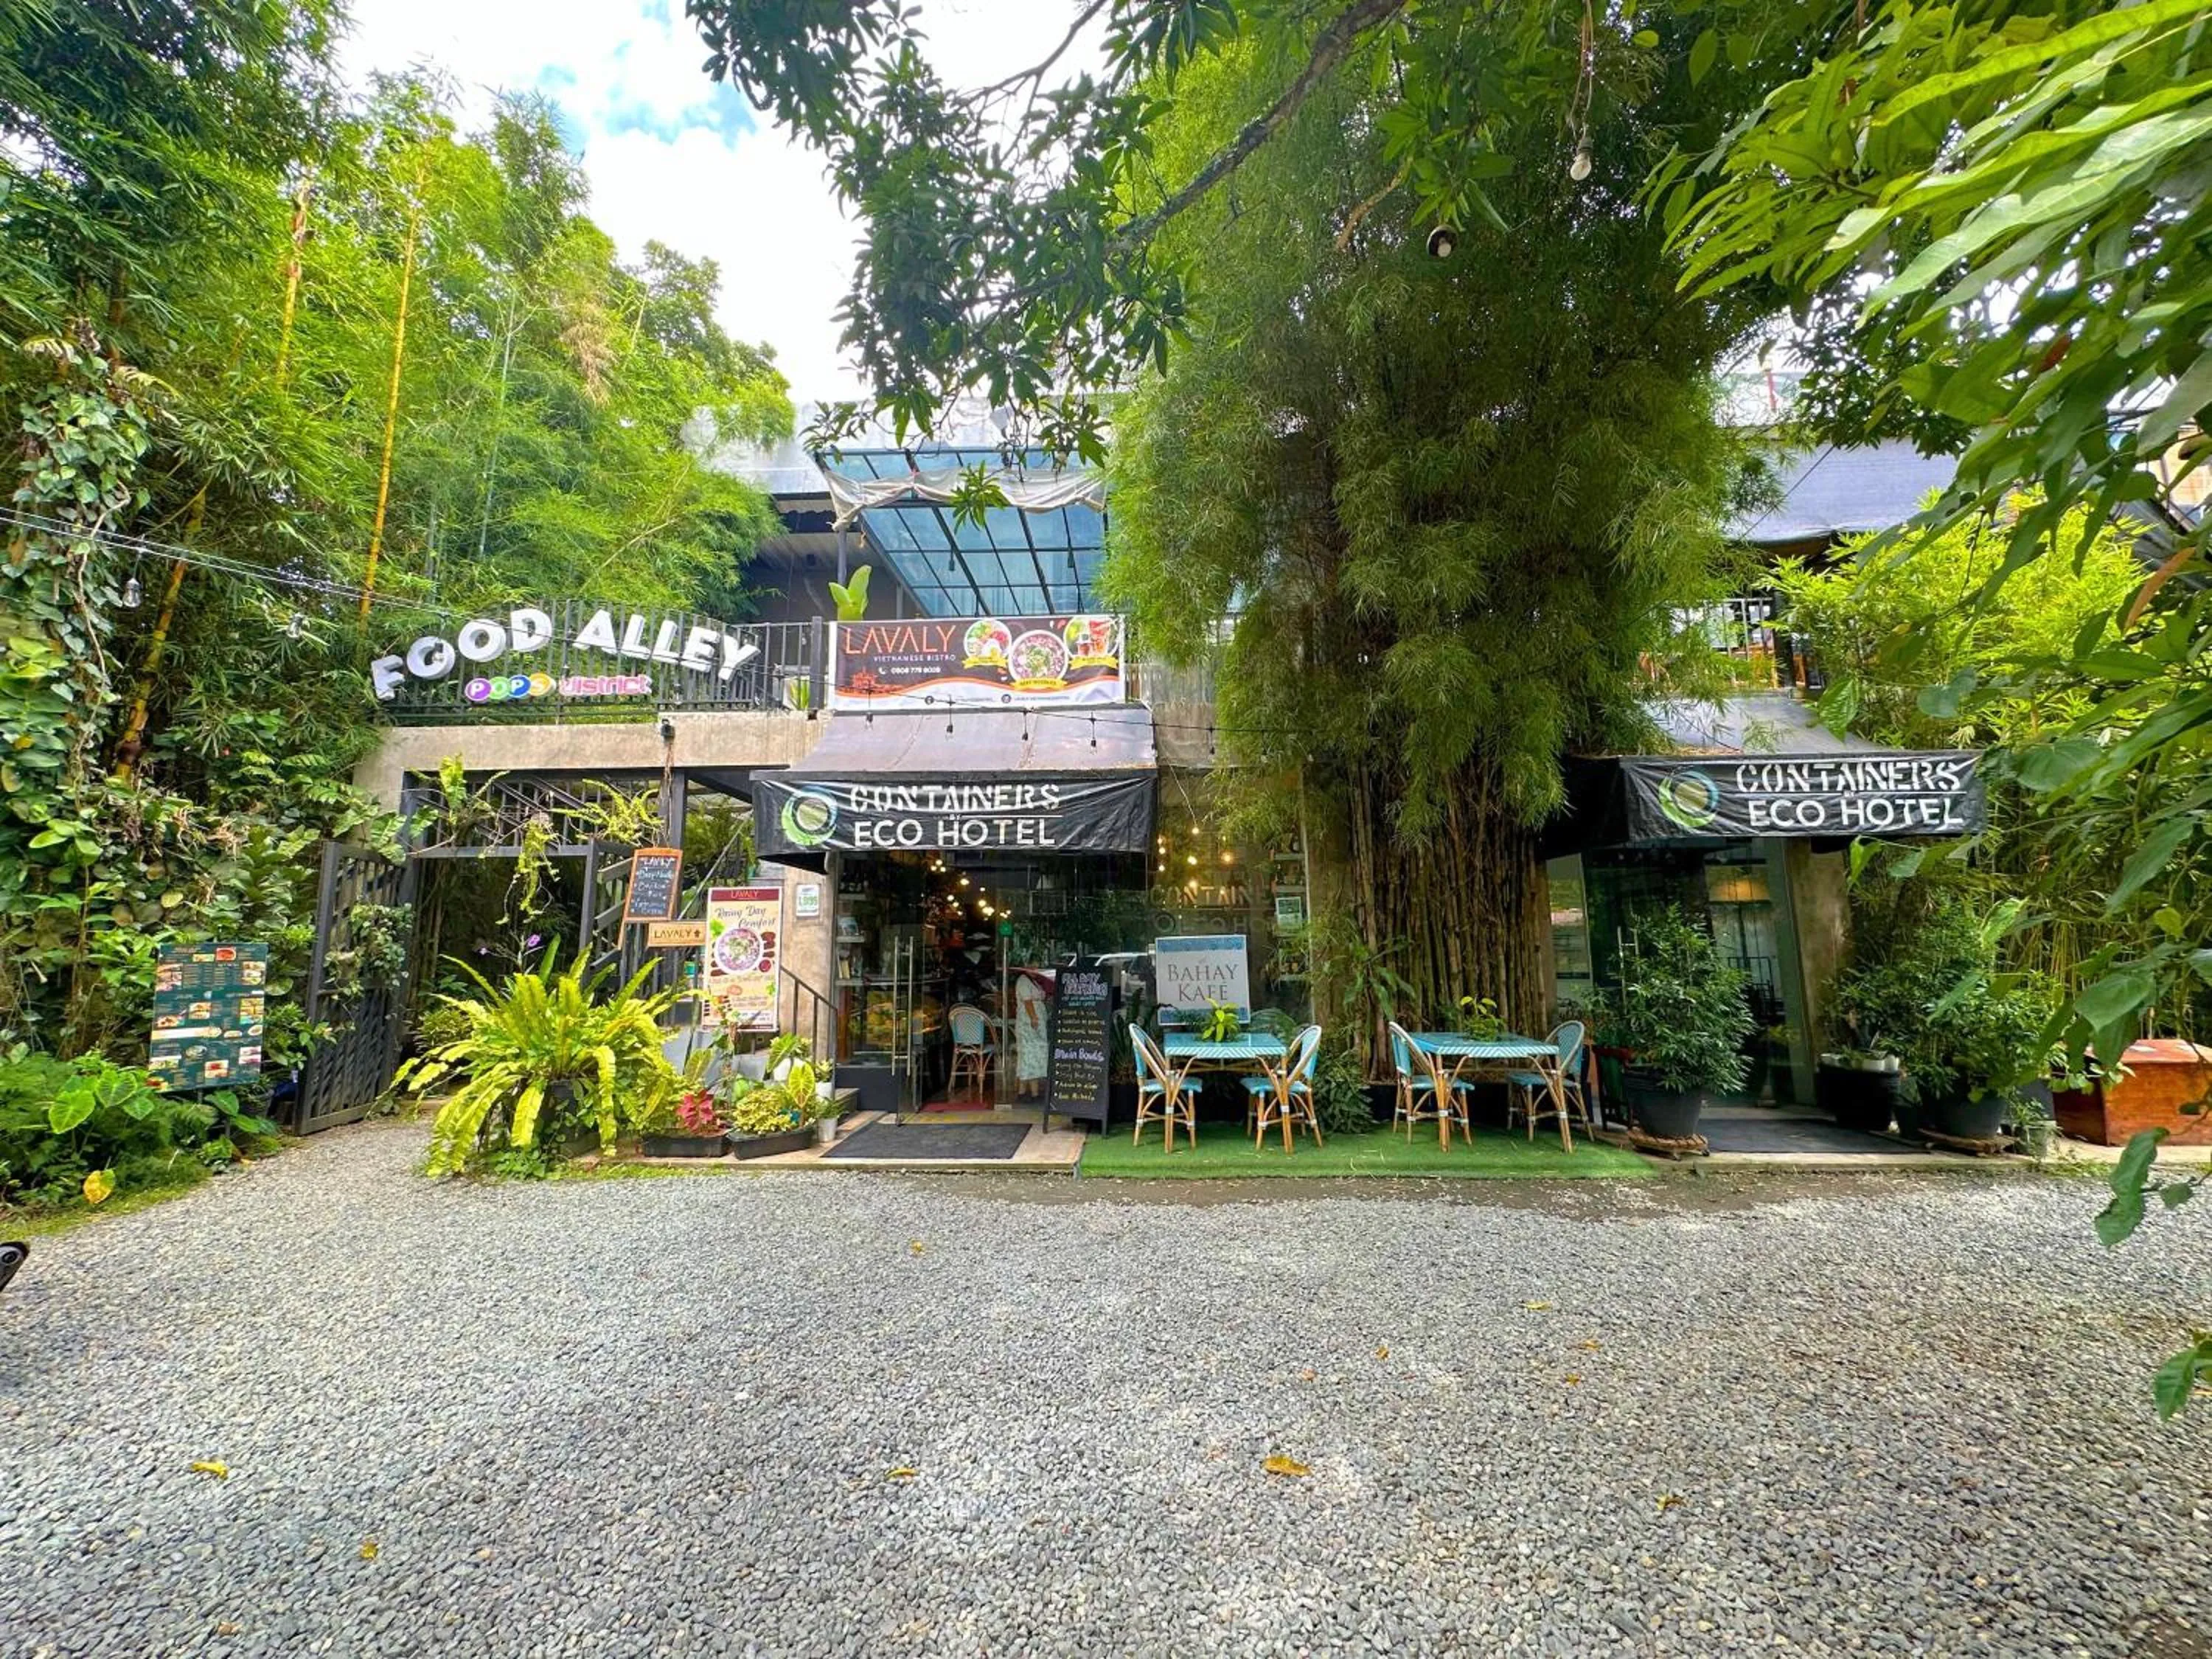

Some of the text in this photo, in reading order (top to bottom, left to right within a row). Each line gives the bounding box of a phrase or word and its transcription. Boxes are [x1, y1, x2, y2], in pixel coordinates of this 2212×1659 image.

[846, 625, 956, 654] LAVALY
[371, 608, 760, 700] FOOD ALLEY
[465, 672, 554, 700] POPS
[1736, 762, 1961, 793] CONTAINERS
[849, 785, 1061, 810] CONTAINERS
[1749, 797, 1964, 827] ECO HOTEL
[854, 818, 1056, 846] ECO HOTEL
[654, 928, 692, 939] LAVALY
[1167, 964, 1239, 981] BAHAY
